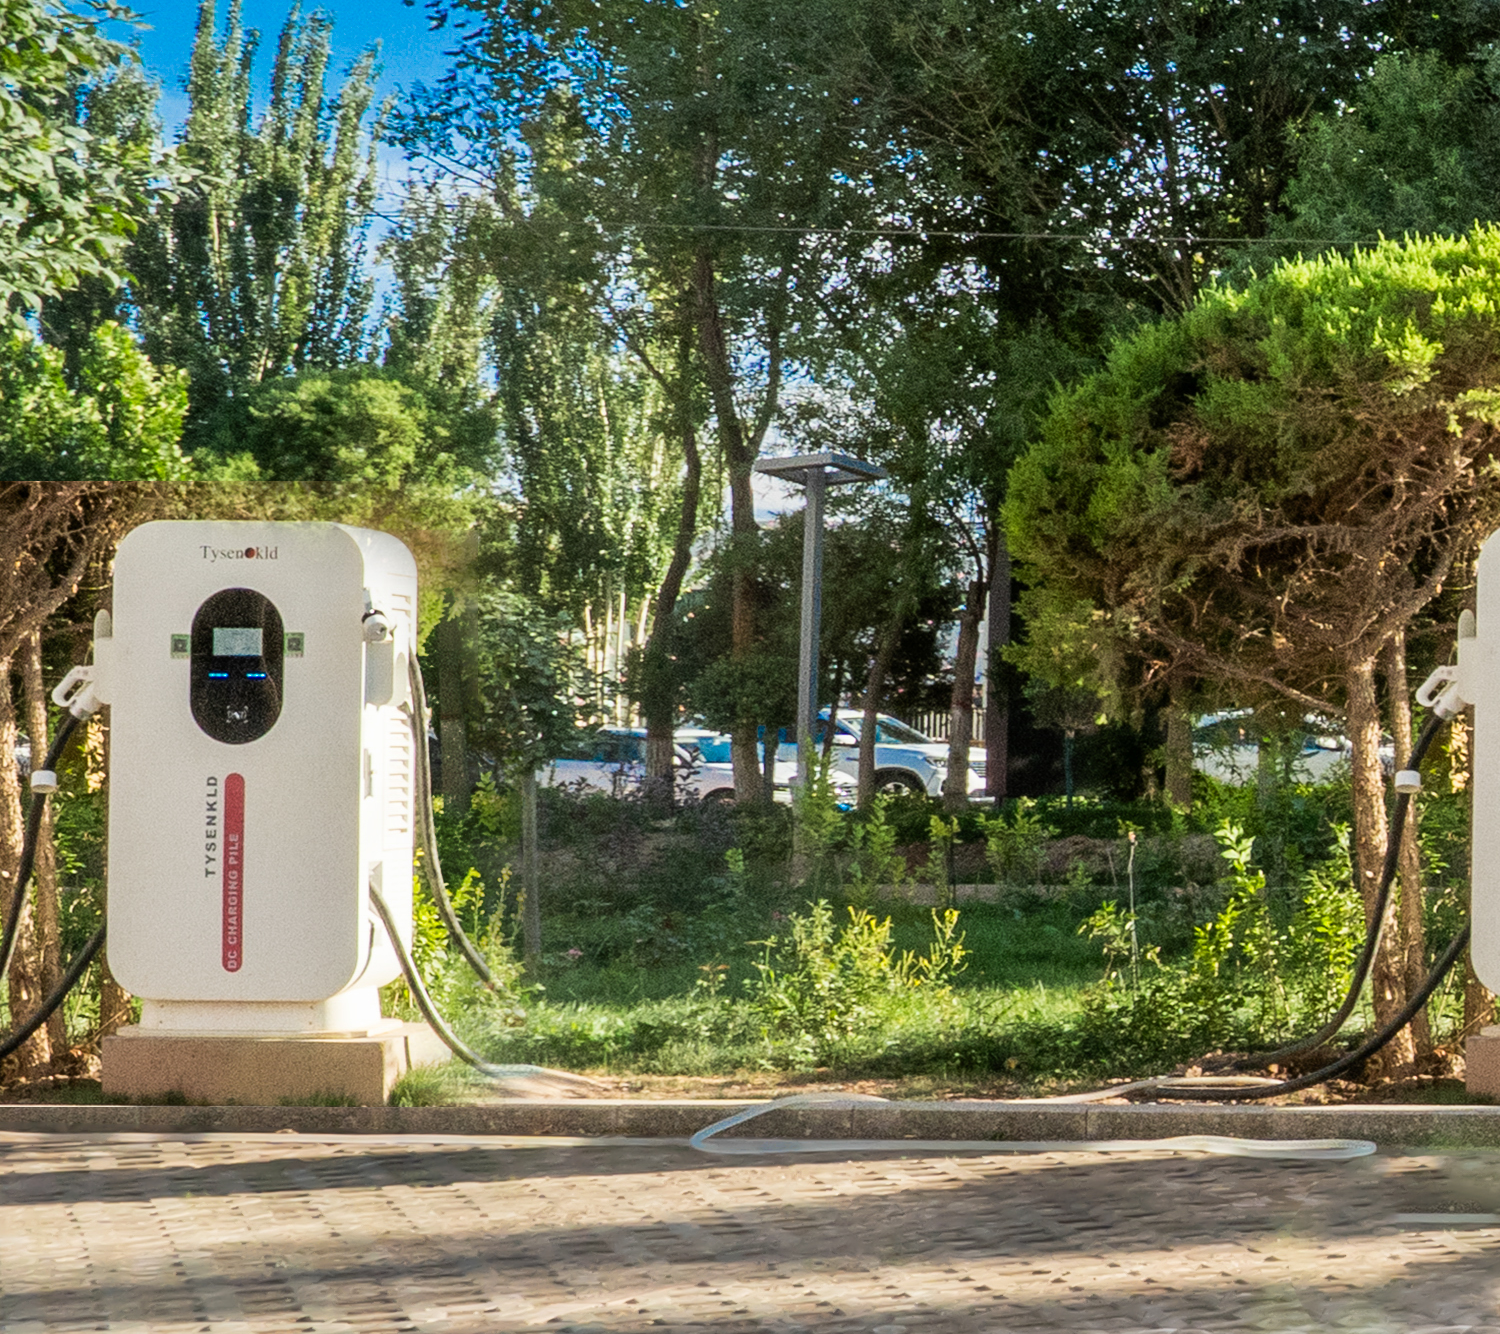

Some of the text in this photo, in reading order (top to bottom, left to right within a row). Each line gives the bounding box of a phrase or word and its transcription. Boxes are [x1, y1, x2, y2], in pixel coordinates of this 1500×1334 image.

[204, 776, 218, 878] TYSENKLD
[227, 833, 239, 969] DC CHARGING PILE
